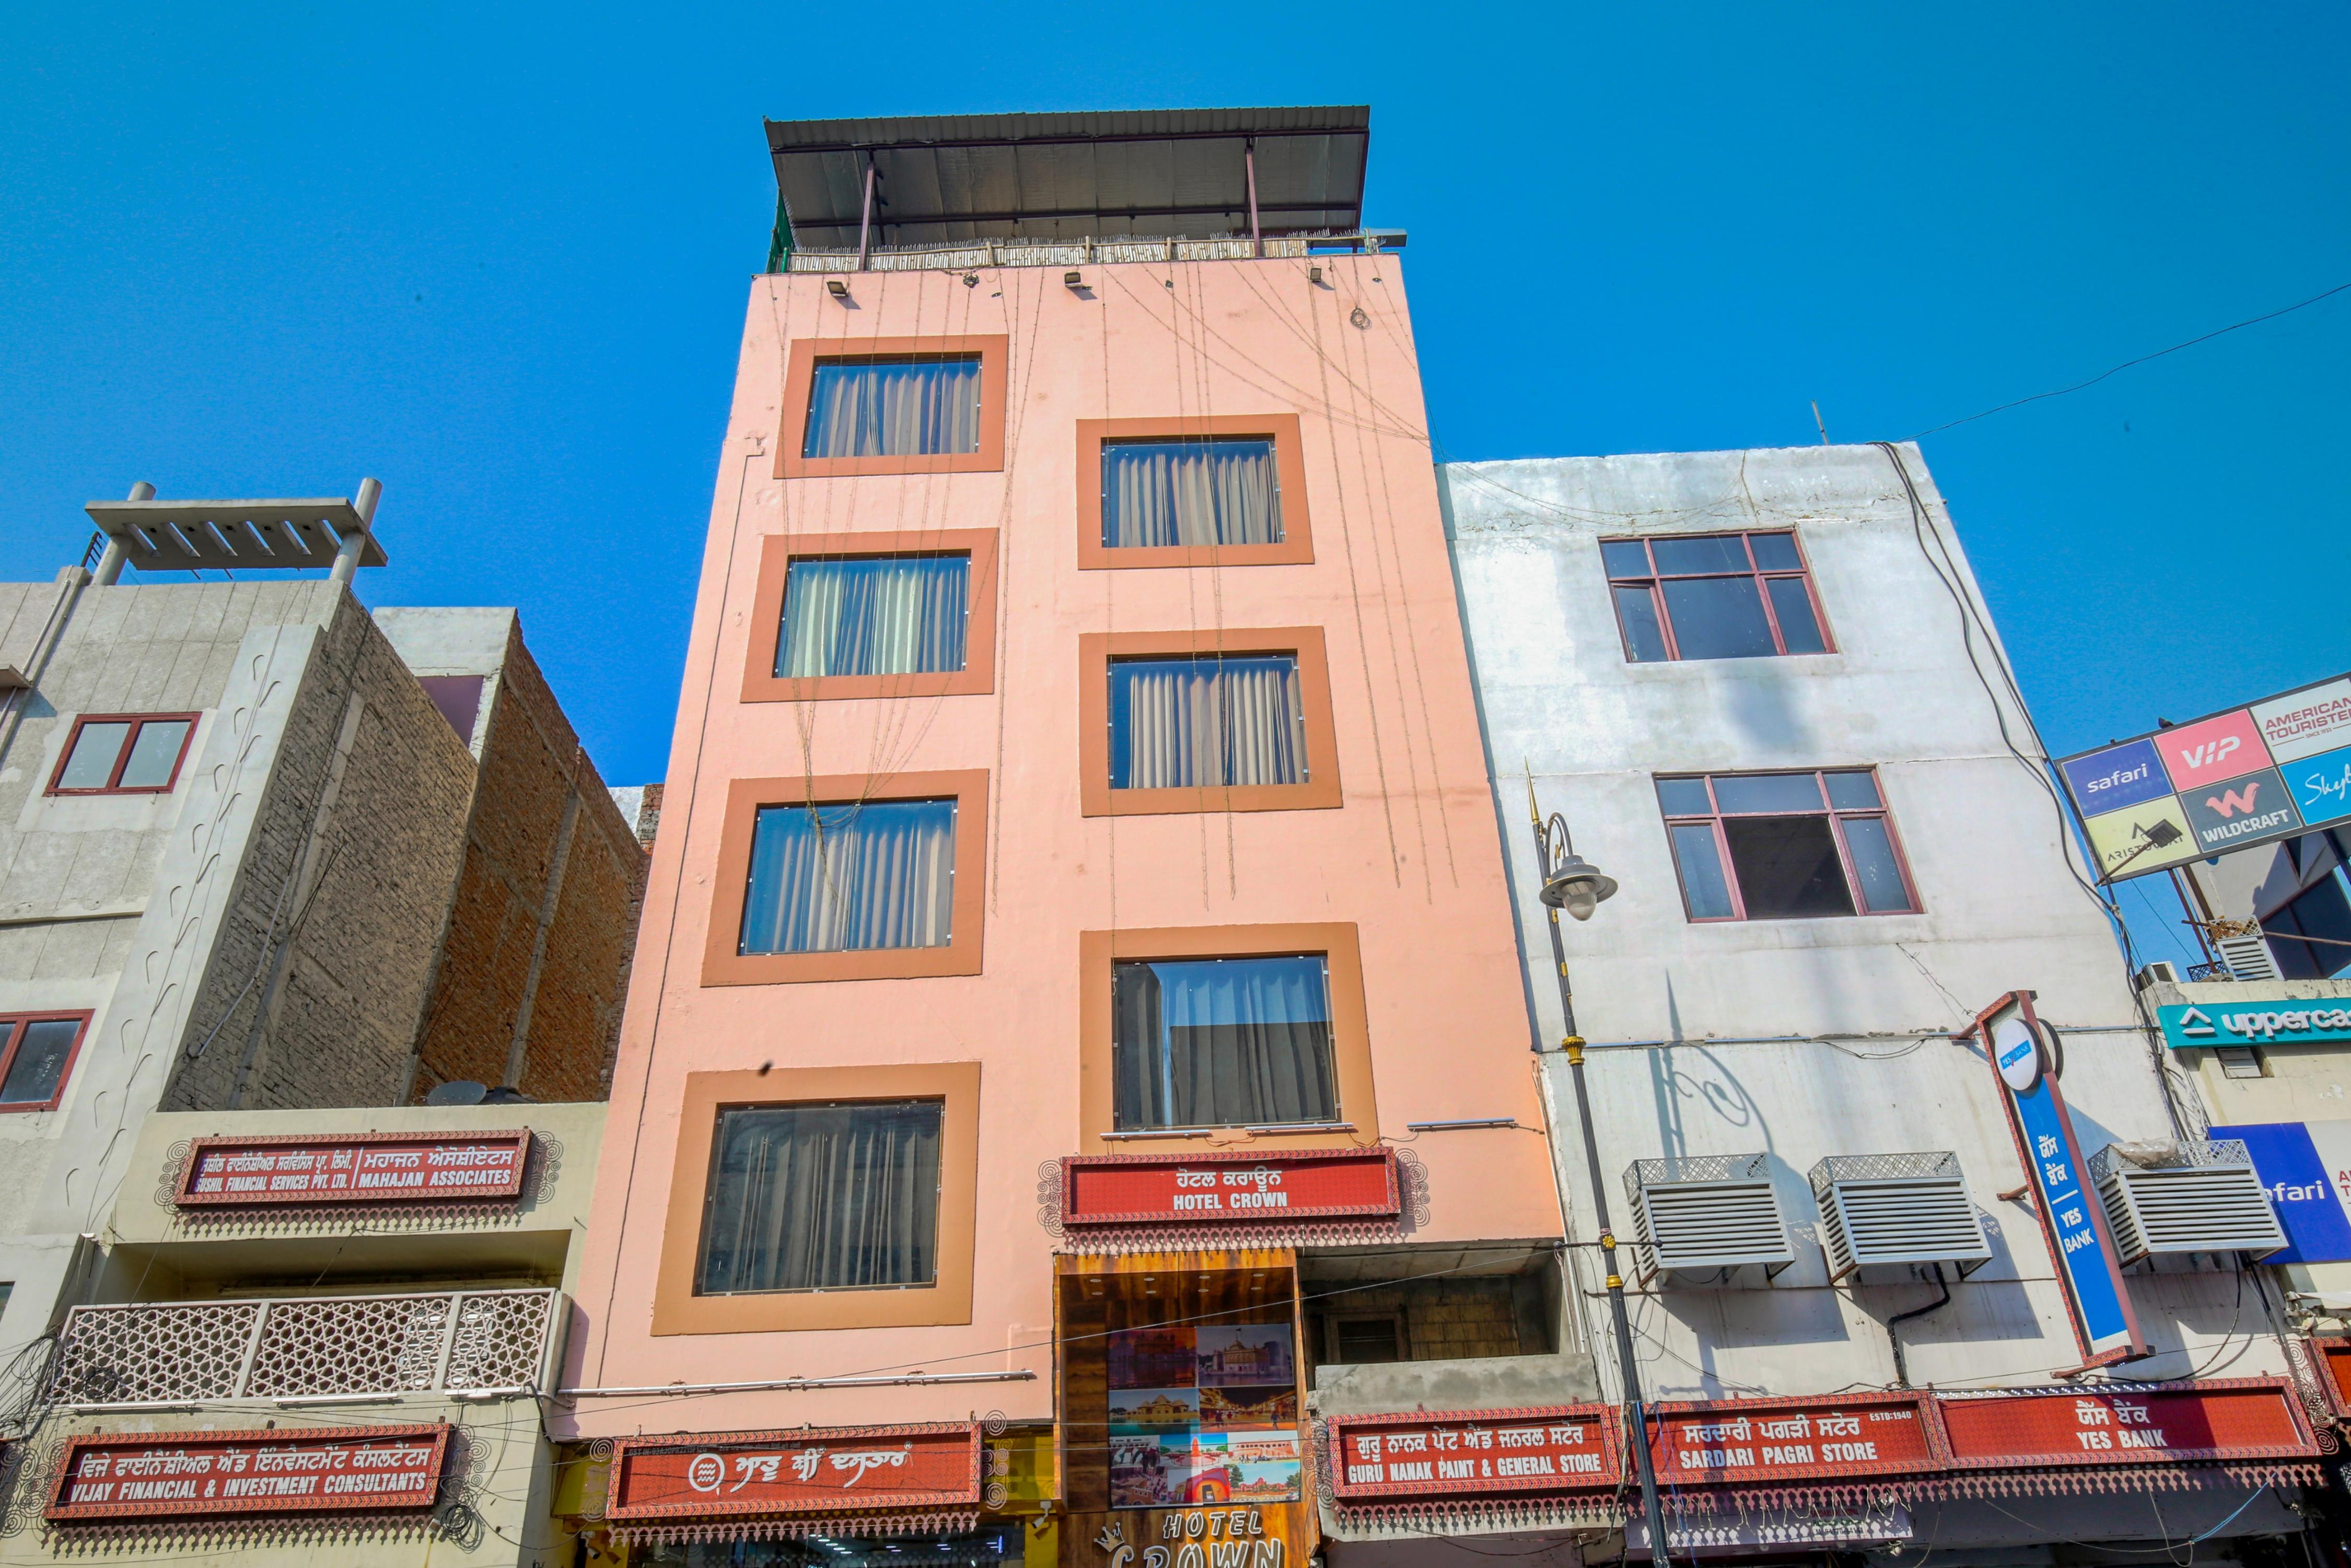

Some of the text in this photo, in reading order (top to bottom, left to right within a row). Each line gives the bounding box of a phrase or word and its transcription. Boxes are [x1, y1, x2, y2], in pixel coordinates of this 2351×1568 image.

[2265, 696, 2351, 730] AMERICAN
[2181, 736, 2241, 769] VIP
[2087, 763, 2148, 794] safari
[2202, 809, 2289, 843] WILDCRAFT
[364, 1153, 422, 1168] ਮਹਾਜਨ
[195, 1174, 347, 1192] SUSHIL FINANCIAL SERVICES PVT. LTD.
[358, 1169, 511, 1188] MAHAJAN ASSOCIATES
[1176, 1165, 1282, 1192] ਹੋਟਲ ਕਰਾਊਨ
[1173, 1192, 1287, 1210] HOTEL CROWN
[2060, 1207, 2082, 1228] YES
[2064, 1227, 2094, 1254] BANK
[1683, 1412, 1861, 1443] ਸਰਦਾਰੀ ਪਗੜੀ ਸਟੋਰ
[1869, 1411, 1912, 1422] ESTD:1940
[1356, 1436, 1381, 1462] ਗੁਰੂ
[1386, 1434, 1427, 1453] ਨਾਨਕ
[1497, 1428, 1544, 1448] ਜਨਰਲ
[1549, 1420, 1583, 1445] ਸਟੋਰ
[2076, 1429, 2168, 1450] YES BANK
[1348, 1454, 1601, 1483] GURU NANAK PAINT & GENERAL STORE
[1680, 1442, 1878, 1469] SARDARI PAGRI STORE
[71, 1472, 426, 1503] VIJAY FINANCIAL & INVESTMENT CONSULTANTS
[1163, 1511, 1262, 1539] HOTEL
